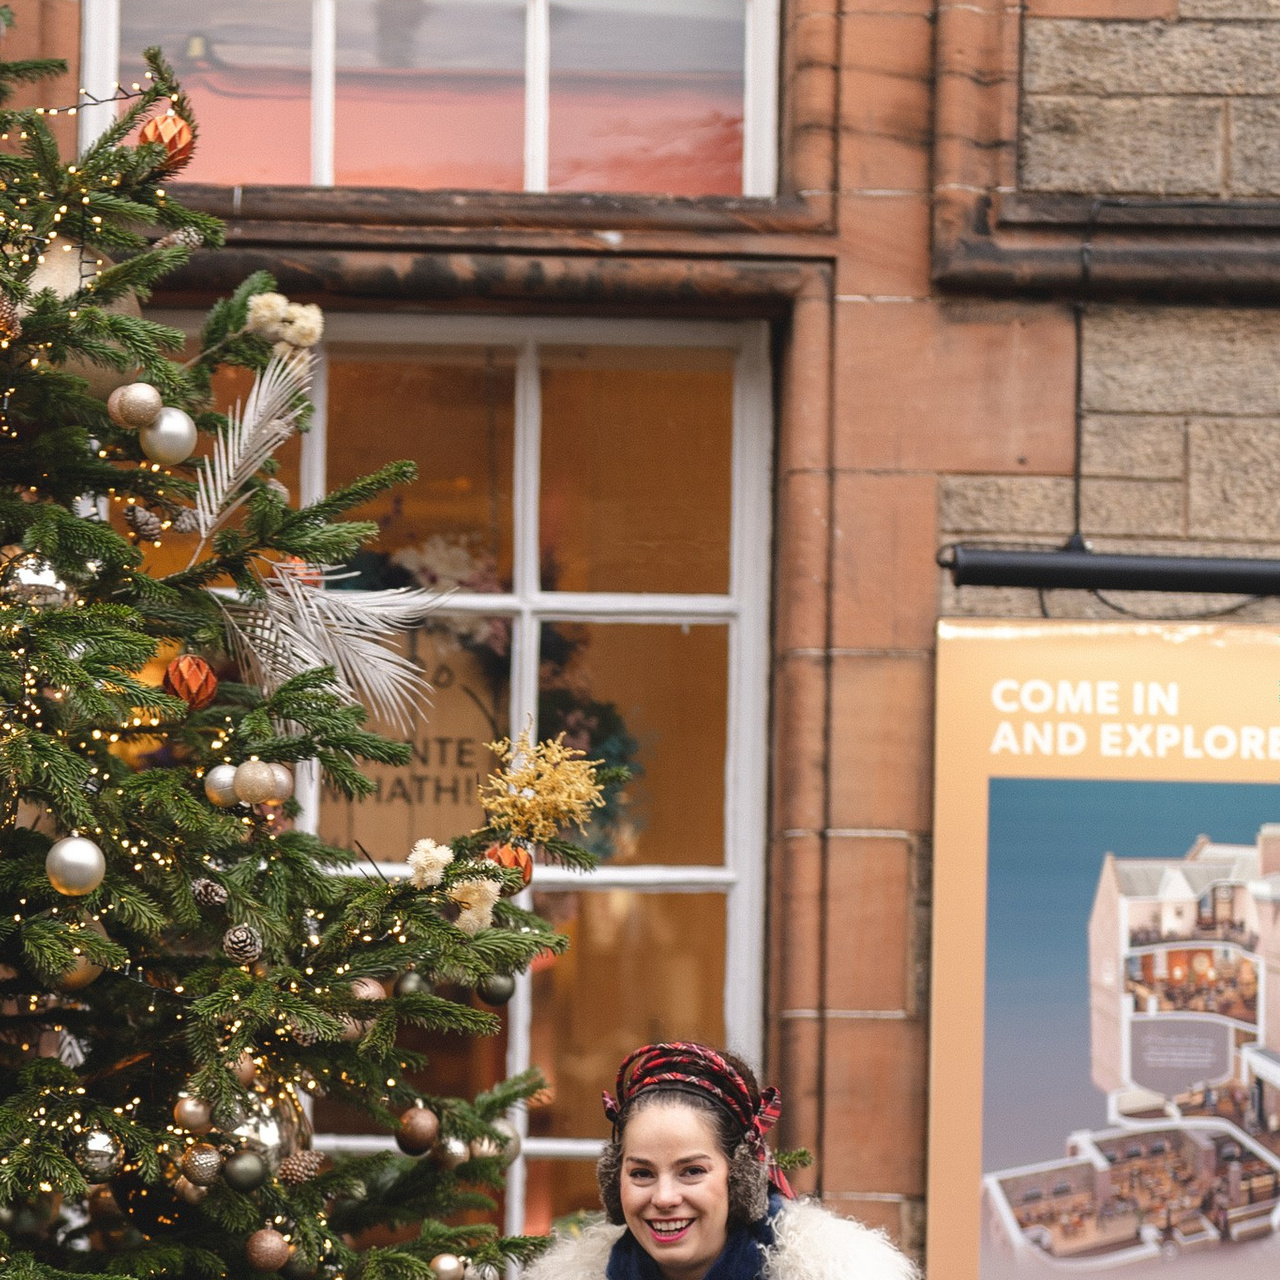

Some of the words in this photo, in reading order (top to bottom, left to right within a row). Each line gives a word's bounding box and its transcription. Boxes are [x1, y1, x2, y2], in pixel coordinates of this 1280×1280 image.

[990, 679, 1119, 715] COME
[1132, 681, 1179, 716] IN
[989, 721, 1087, 756] AND
